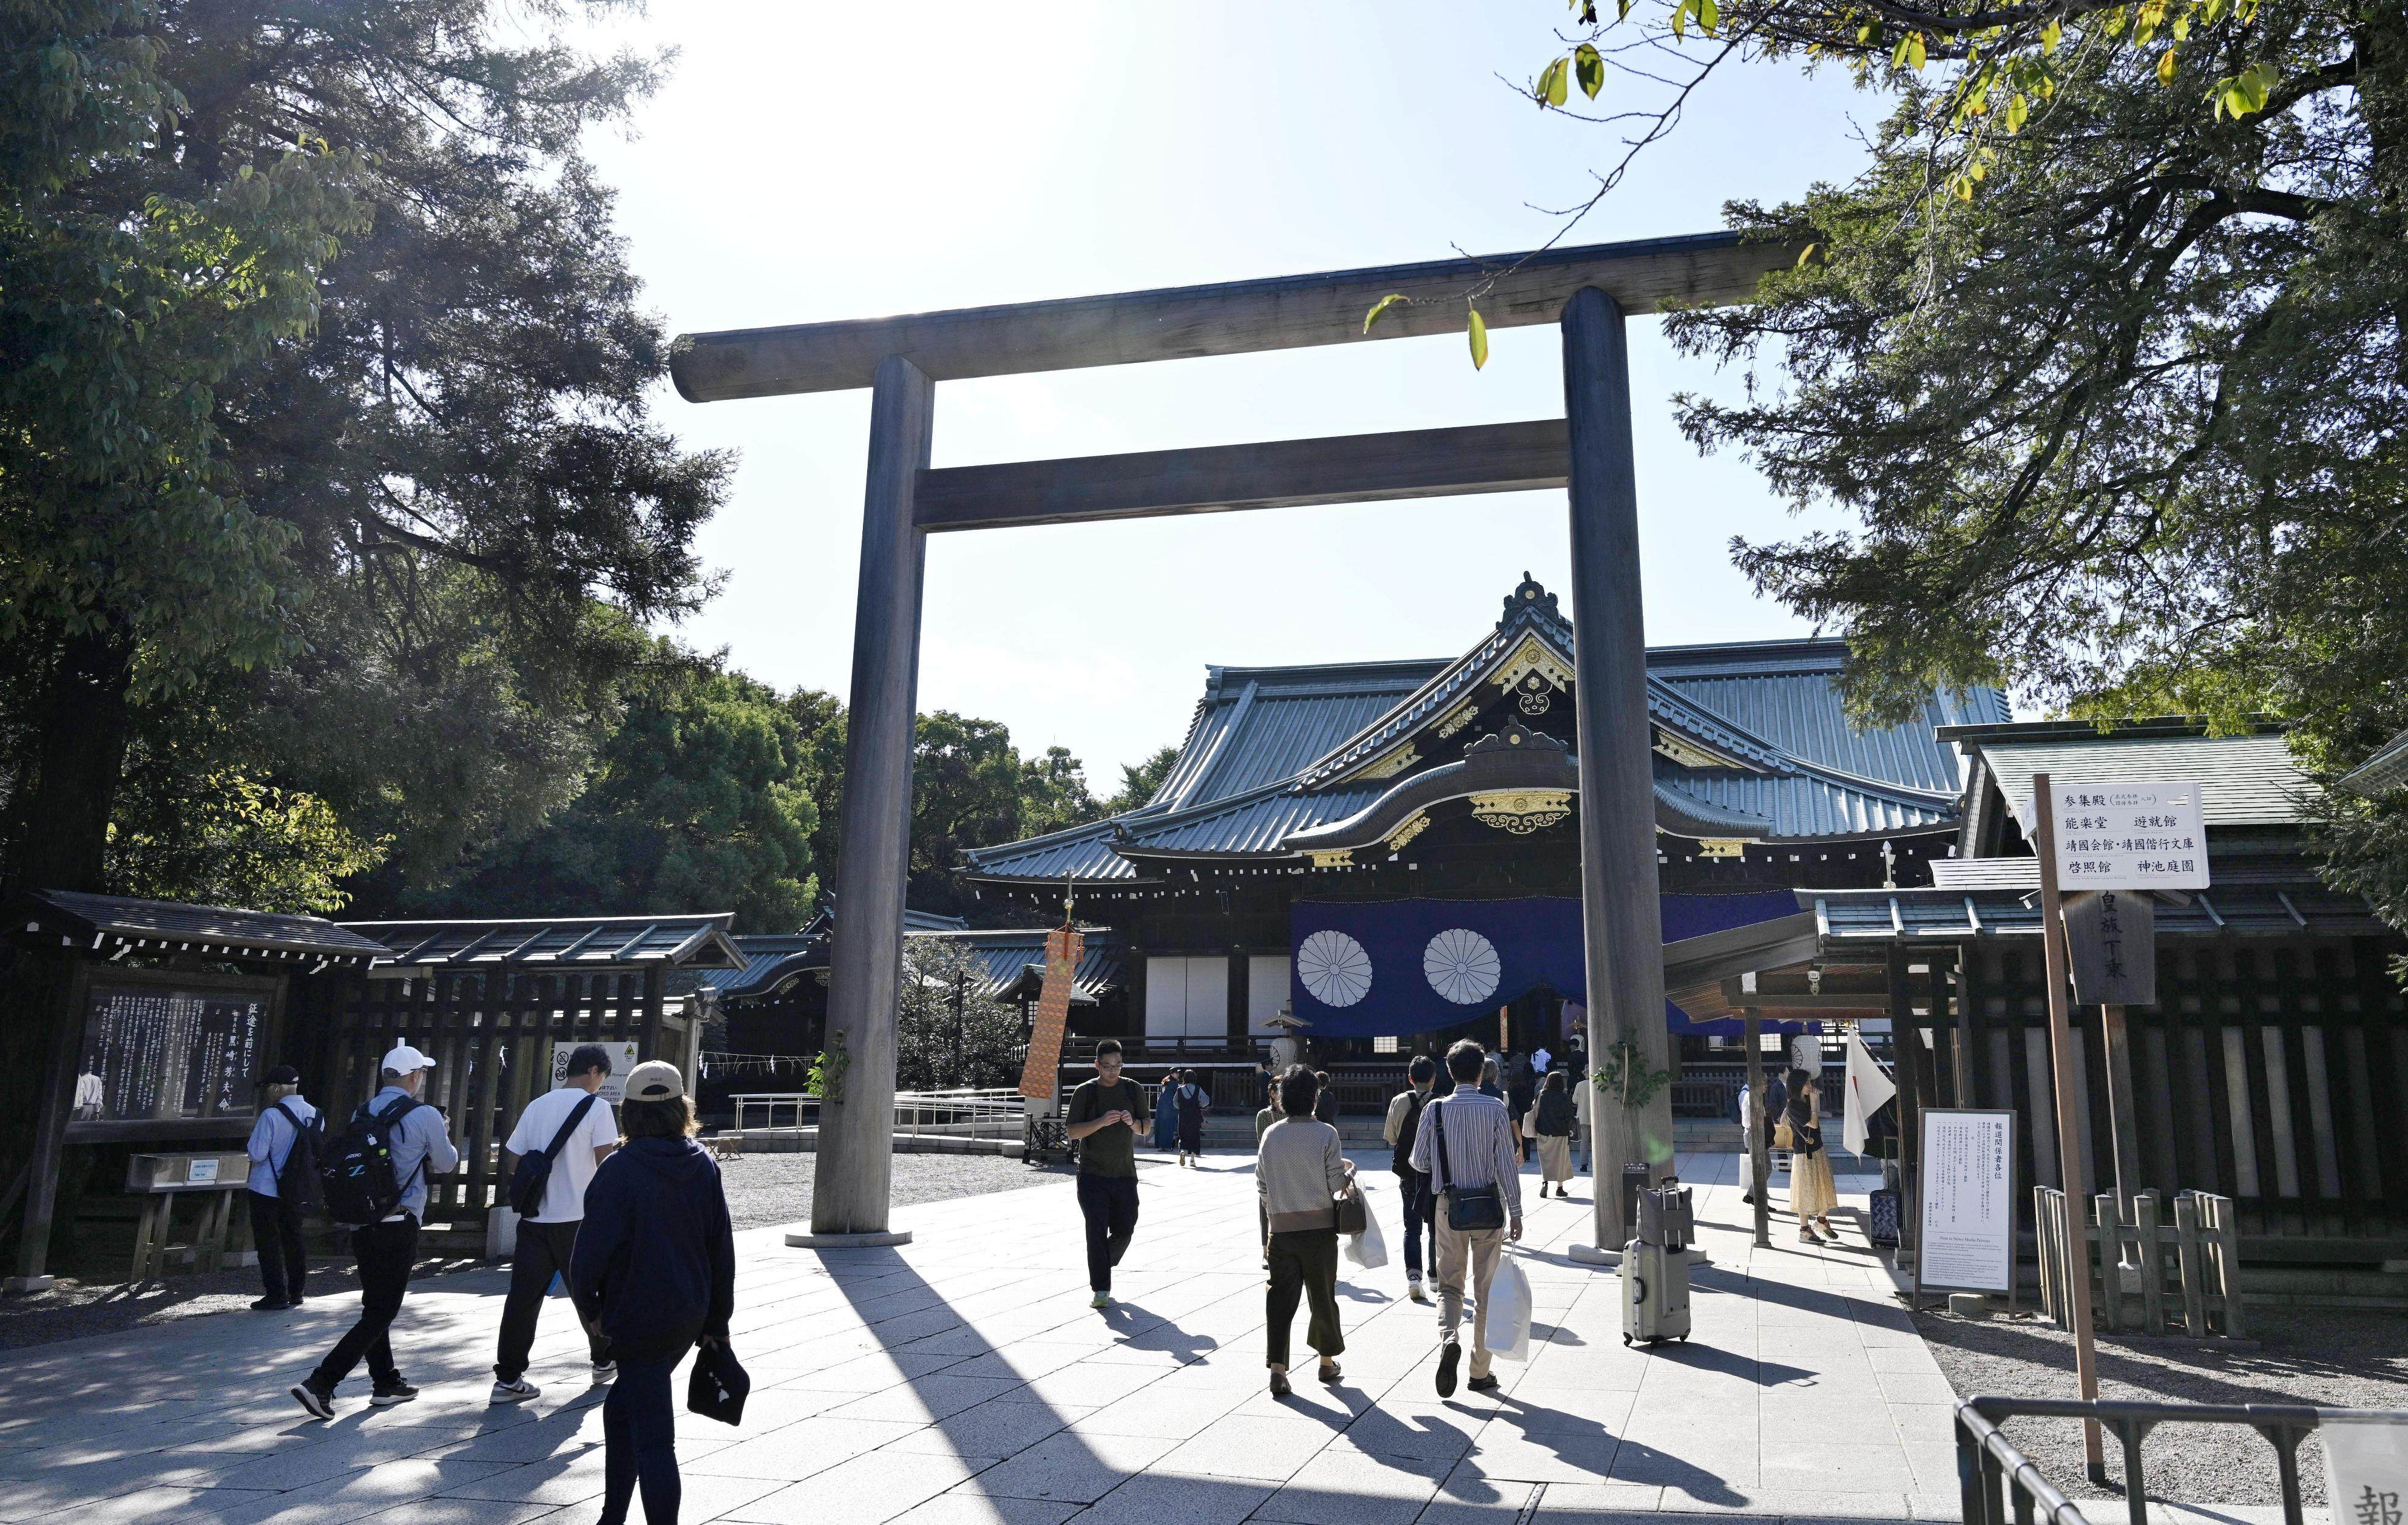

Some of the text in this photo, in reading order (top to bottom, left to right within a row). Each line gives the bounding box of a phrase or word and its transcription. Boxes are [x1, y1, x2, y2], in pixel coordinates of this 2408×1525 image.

[2065, 794, 2106, 807] 参集殿
[2065, 816, 2108, 830] 能楽堂
[2134, 816, 2177, 828] 遊就館
[2066, 837, 2194, 852] 靖國会館・靖國偕行文庫
[2068, 861, 2111, 873] 啓照館
[2137, 860, 2194, 872] 神池庭園
[242, 1003, 258, 1078] 征途を前にして
[2353, 1484, 2403, 1525] 報
